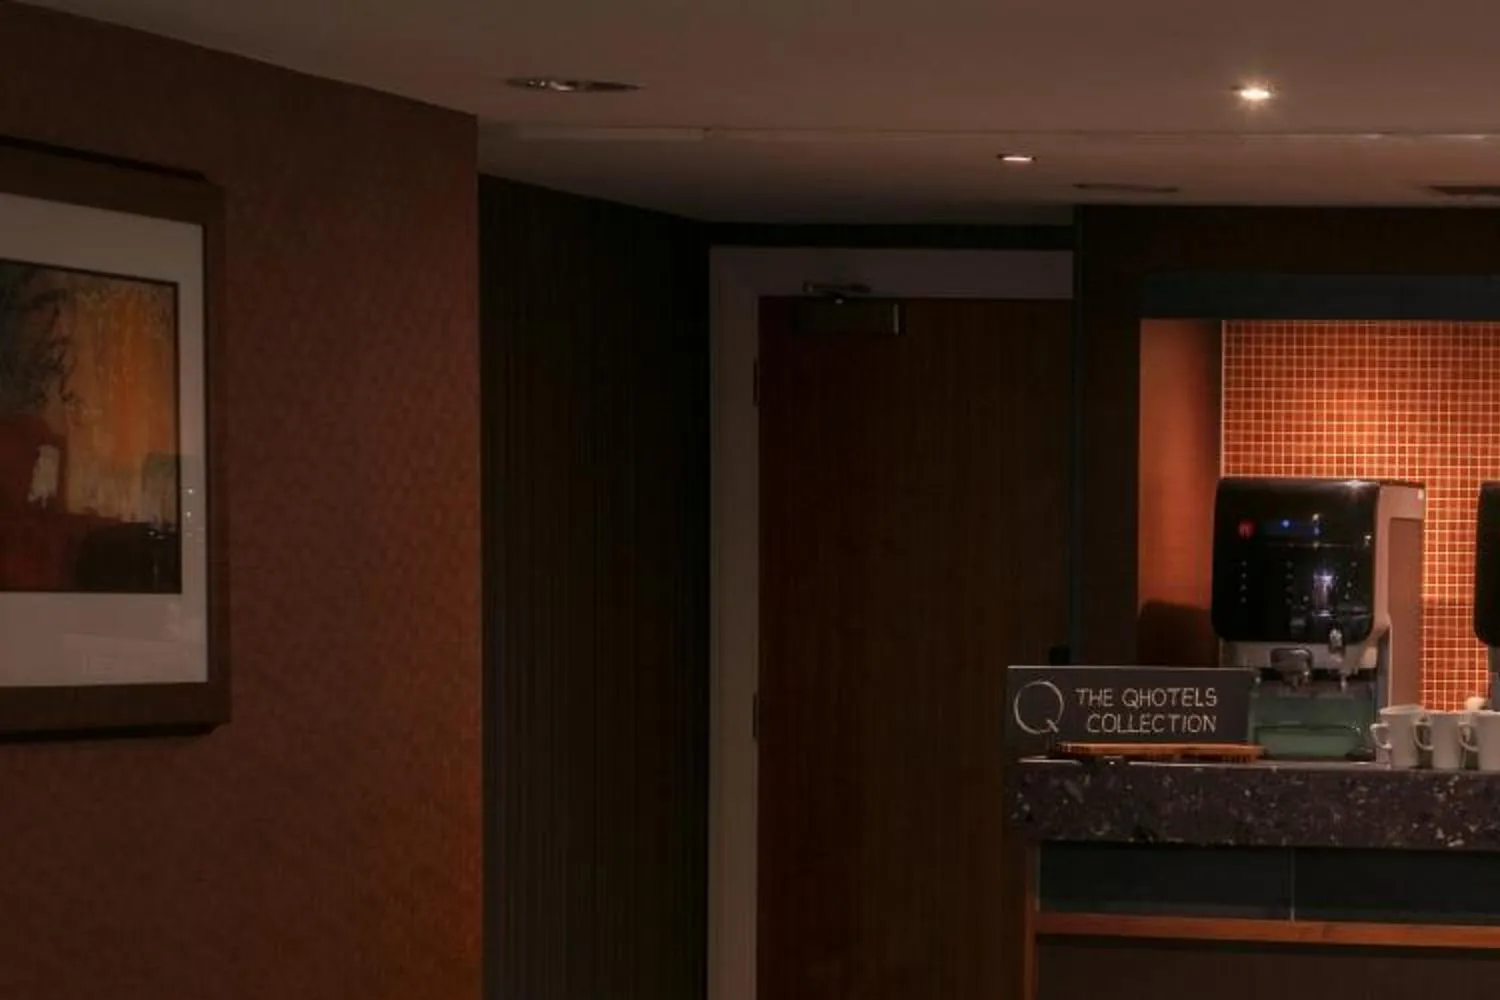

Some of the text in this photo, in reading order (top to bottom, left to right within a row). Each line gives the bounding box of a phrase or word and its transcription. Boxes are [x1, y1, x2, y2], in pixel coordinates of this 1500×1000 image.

[1013, 681, 1065, 735] Q
[1076, 688, 1218, 709] THE QHOTELS
[1087, 713, 1217, 733] COLLECTION
